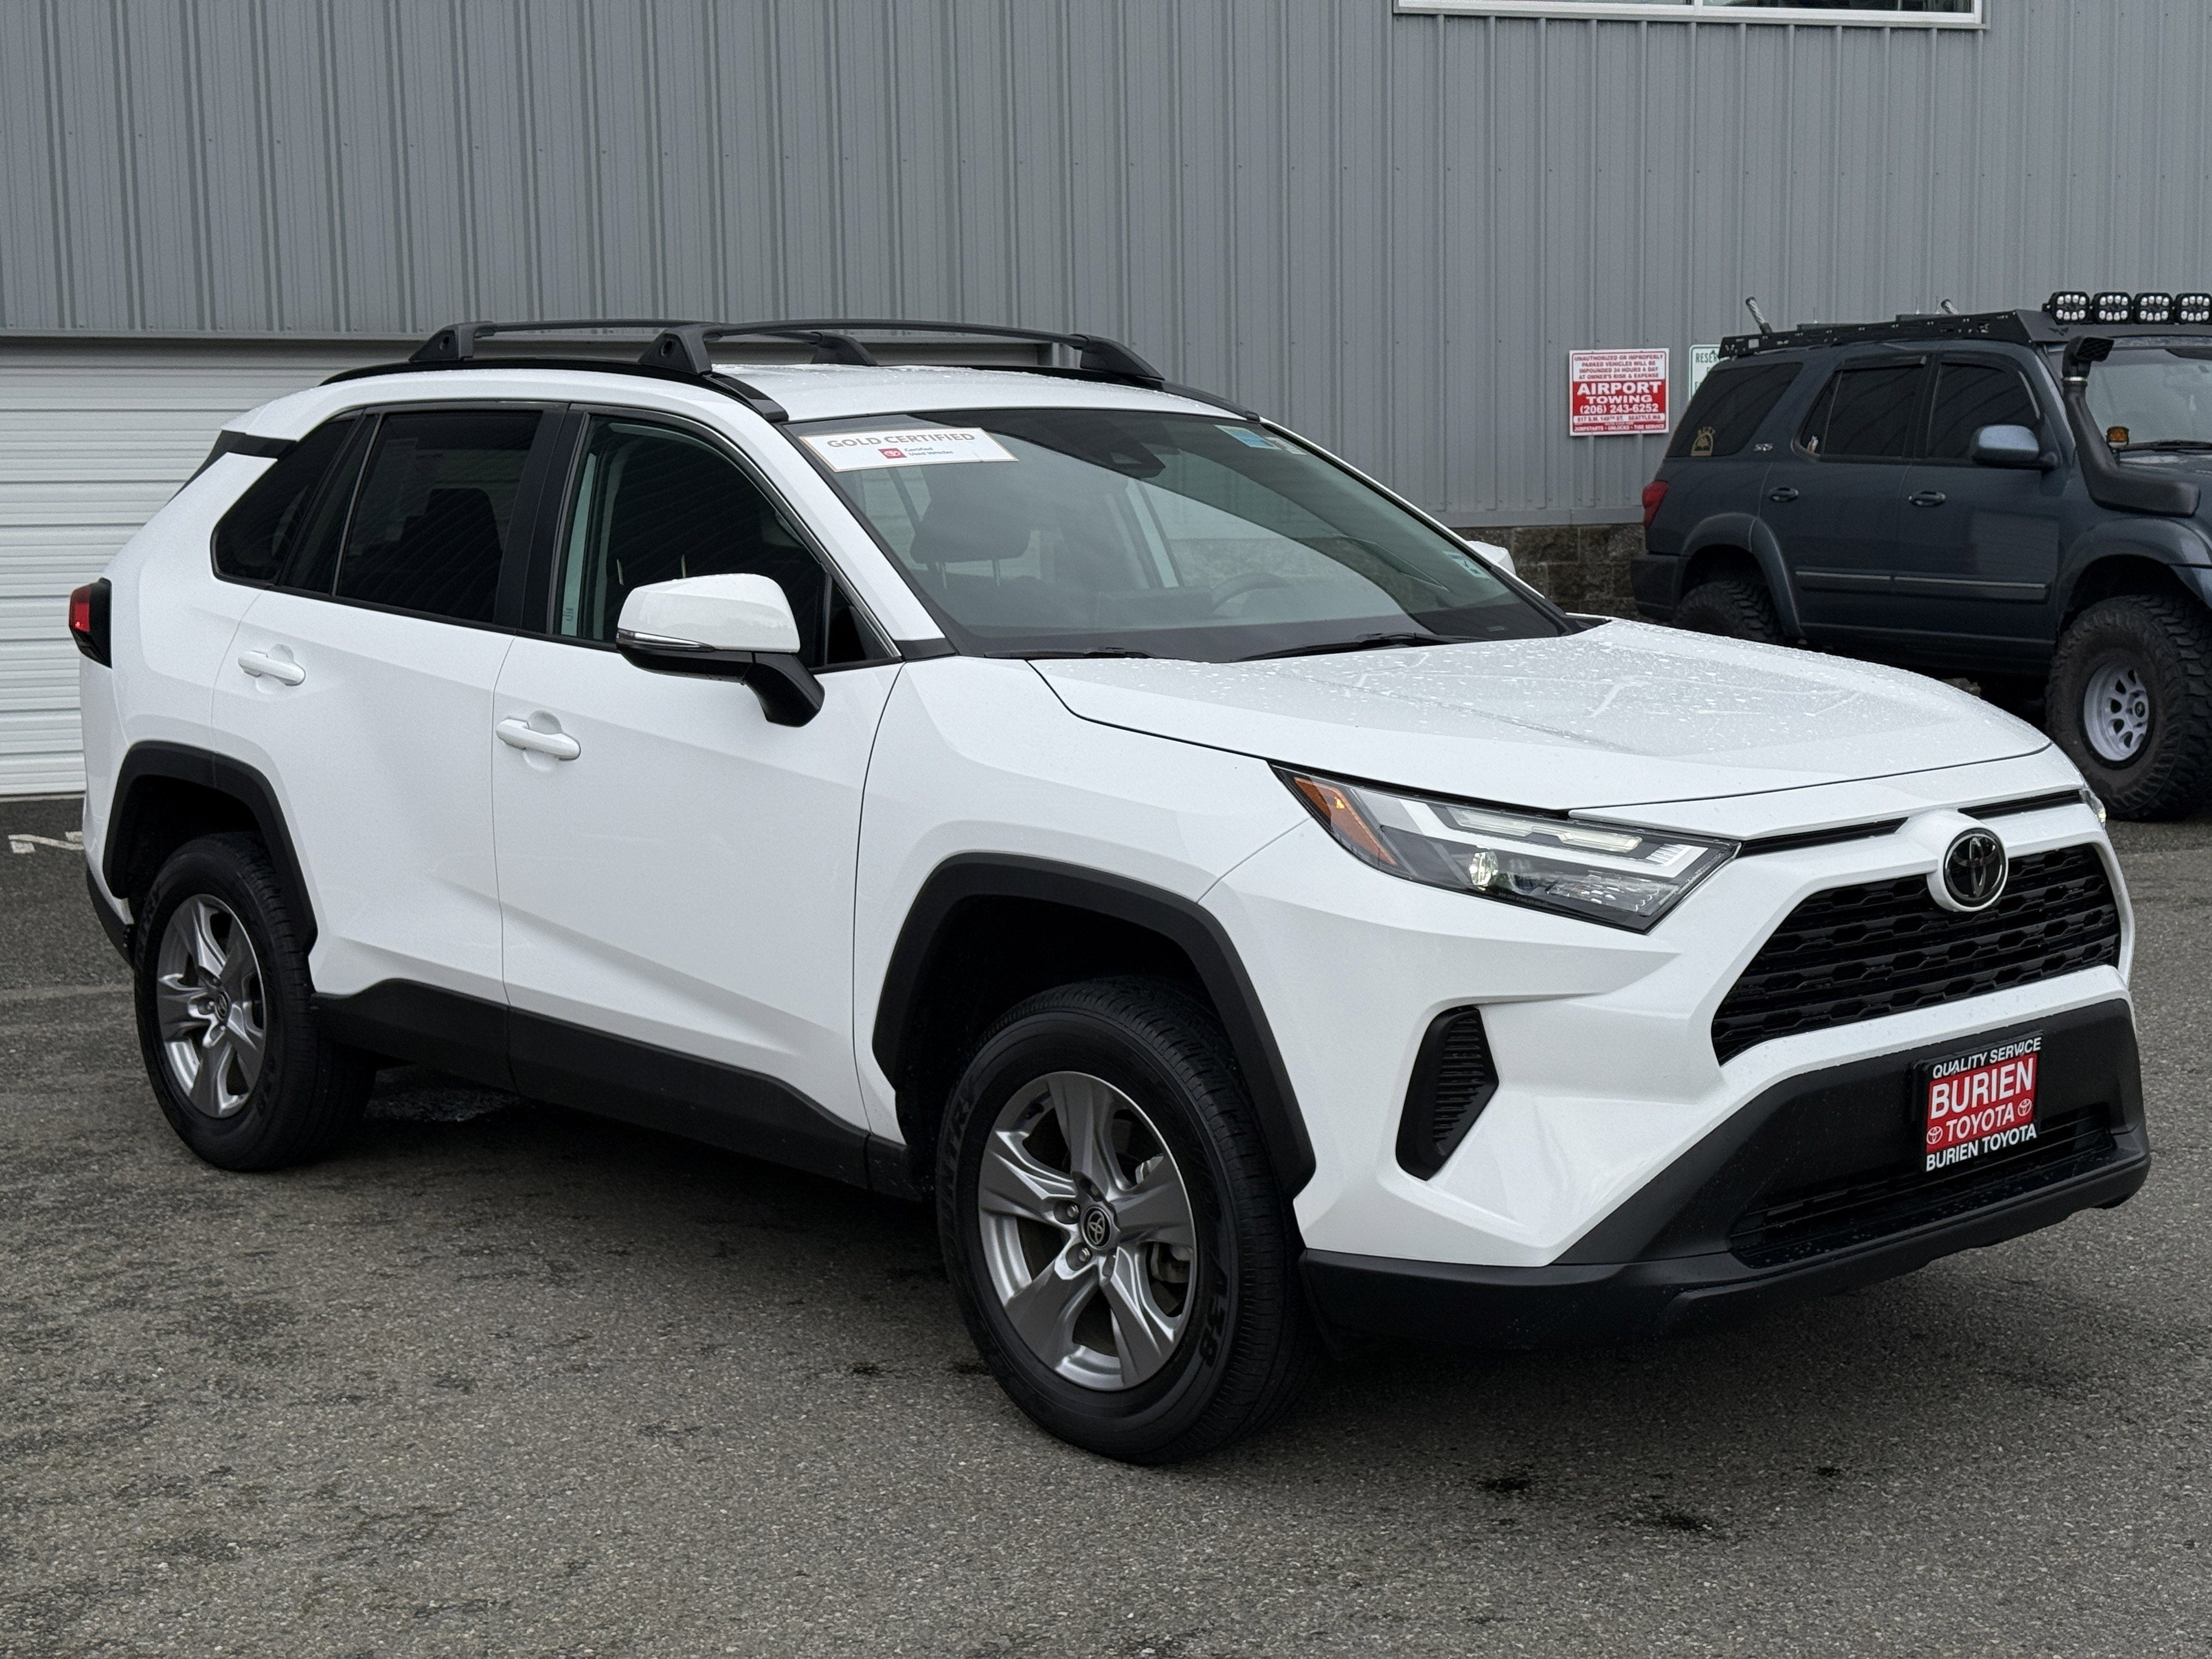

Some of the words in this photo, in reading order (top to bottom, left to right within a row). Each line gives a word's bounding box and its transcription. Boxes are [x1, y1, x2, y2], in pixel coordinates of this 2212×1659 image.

[1577, 381, 1662, 396] AIRPORT
[1586, 394, 1652, 404] TOWING
[1580, 404, 1607, 415] (206)
[1610, 403, 1659, 413] 243-6252
[827, 437, 882, 448] GOLD
[884, 433, 975, 444] CERTIFIED
[1933, 1052, 1987, 1079] QUALITY
[1990, 1037, 2041, 1063] SERVICE
[1931, 1057, 2033, 1119] BURIEN
[1946, 1102, 2015, 1142] TOYOTA
[1926, 1140, 1978, 1172] BURIEN
[1982, 1123, 2037, 1153] TOYOTA
